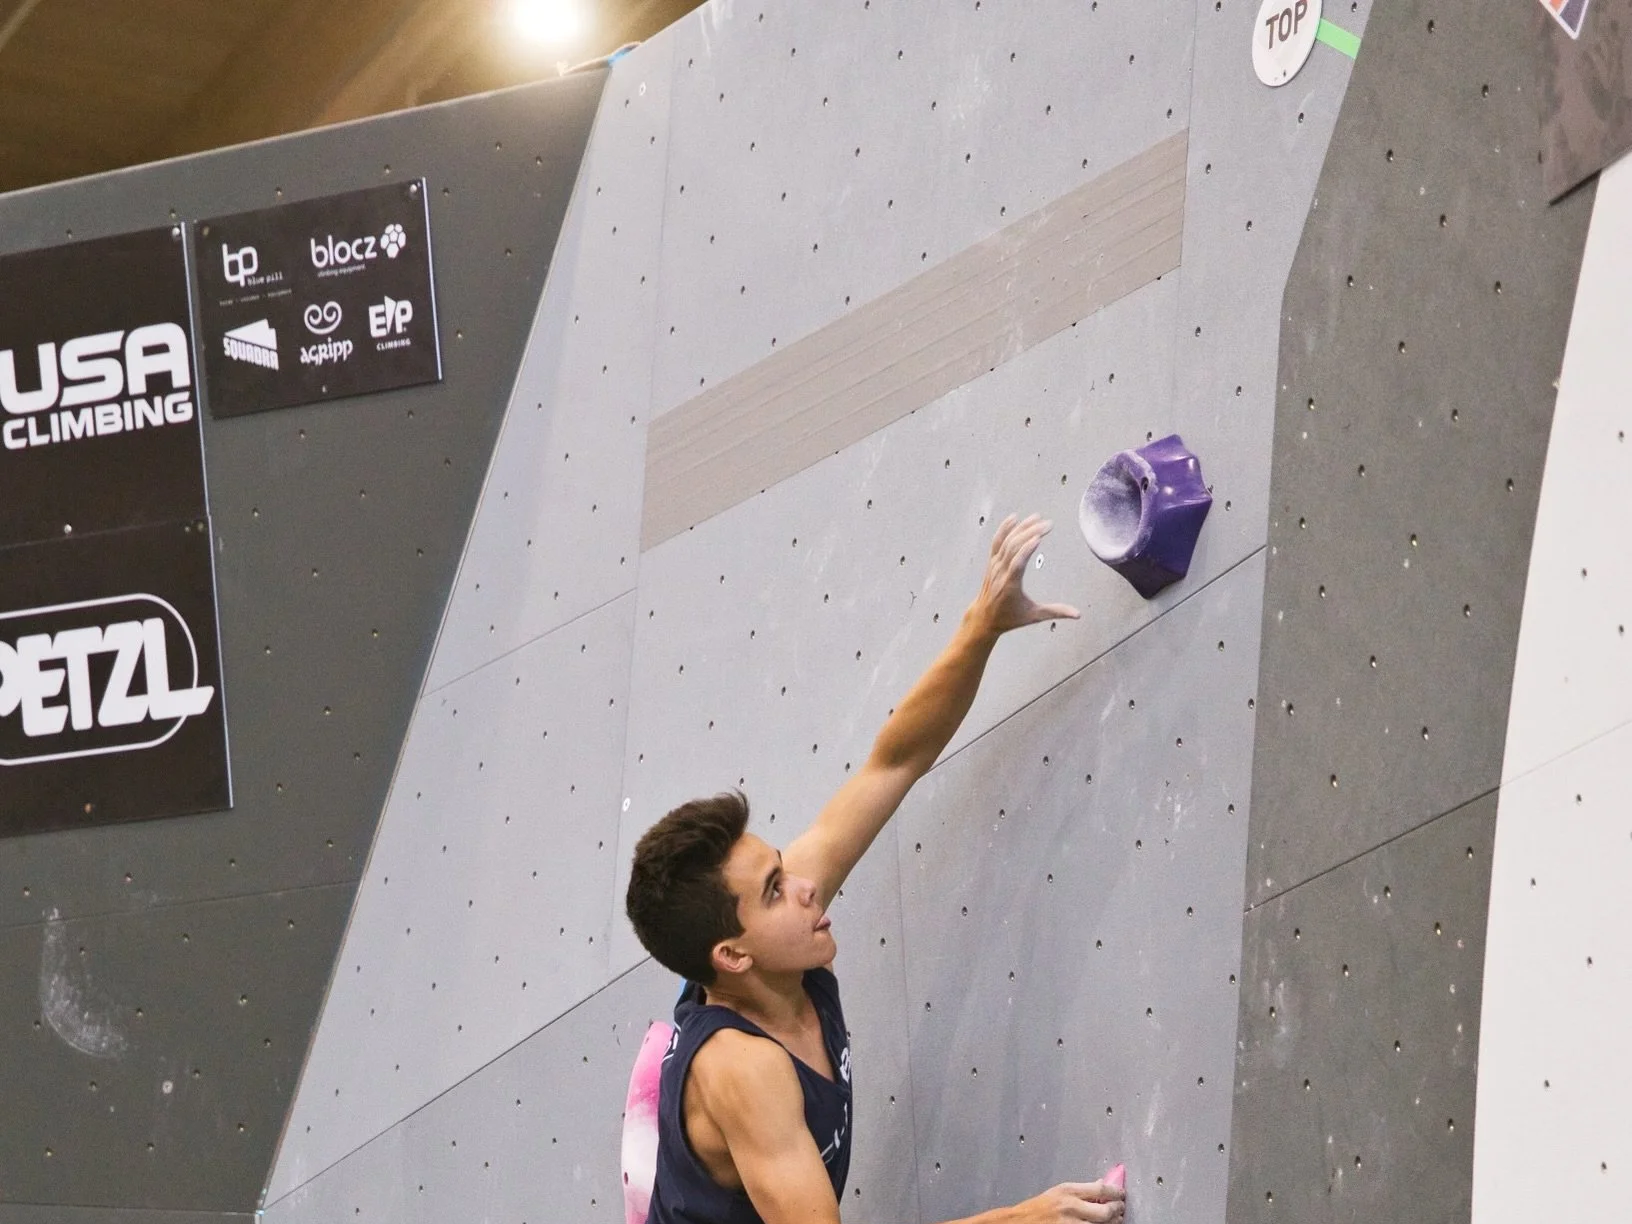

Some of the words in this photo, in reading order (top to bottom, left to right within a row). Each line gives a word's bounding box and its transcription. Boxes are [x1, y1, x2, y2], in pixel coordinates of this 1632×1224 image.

[1265, 0, 1308, 50] TOP
[222, 243, 258, 287] bp
[310, 234, 377, 268] blocz
[247, 275, 265, 286] blue
[266, 270, 283, 283] pill
[223, 337, 279, 371] SQUADRA
[376, 338, 411, 352] CLIMBING
[0, 322, 191, 415] USA
[3, 391, 193, 450] CLIMBING
